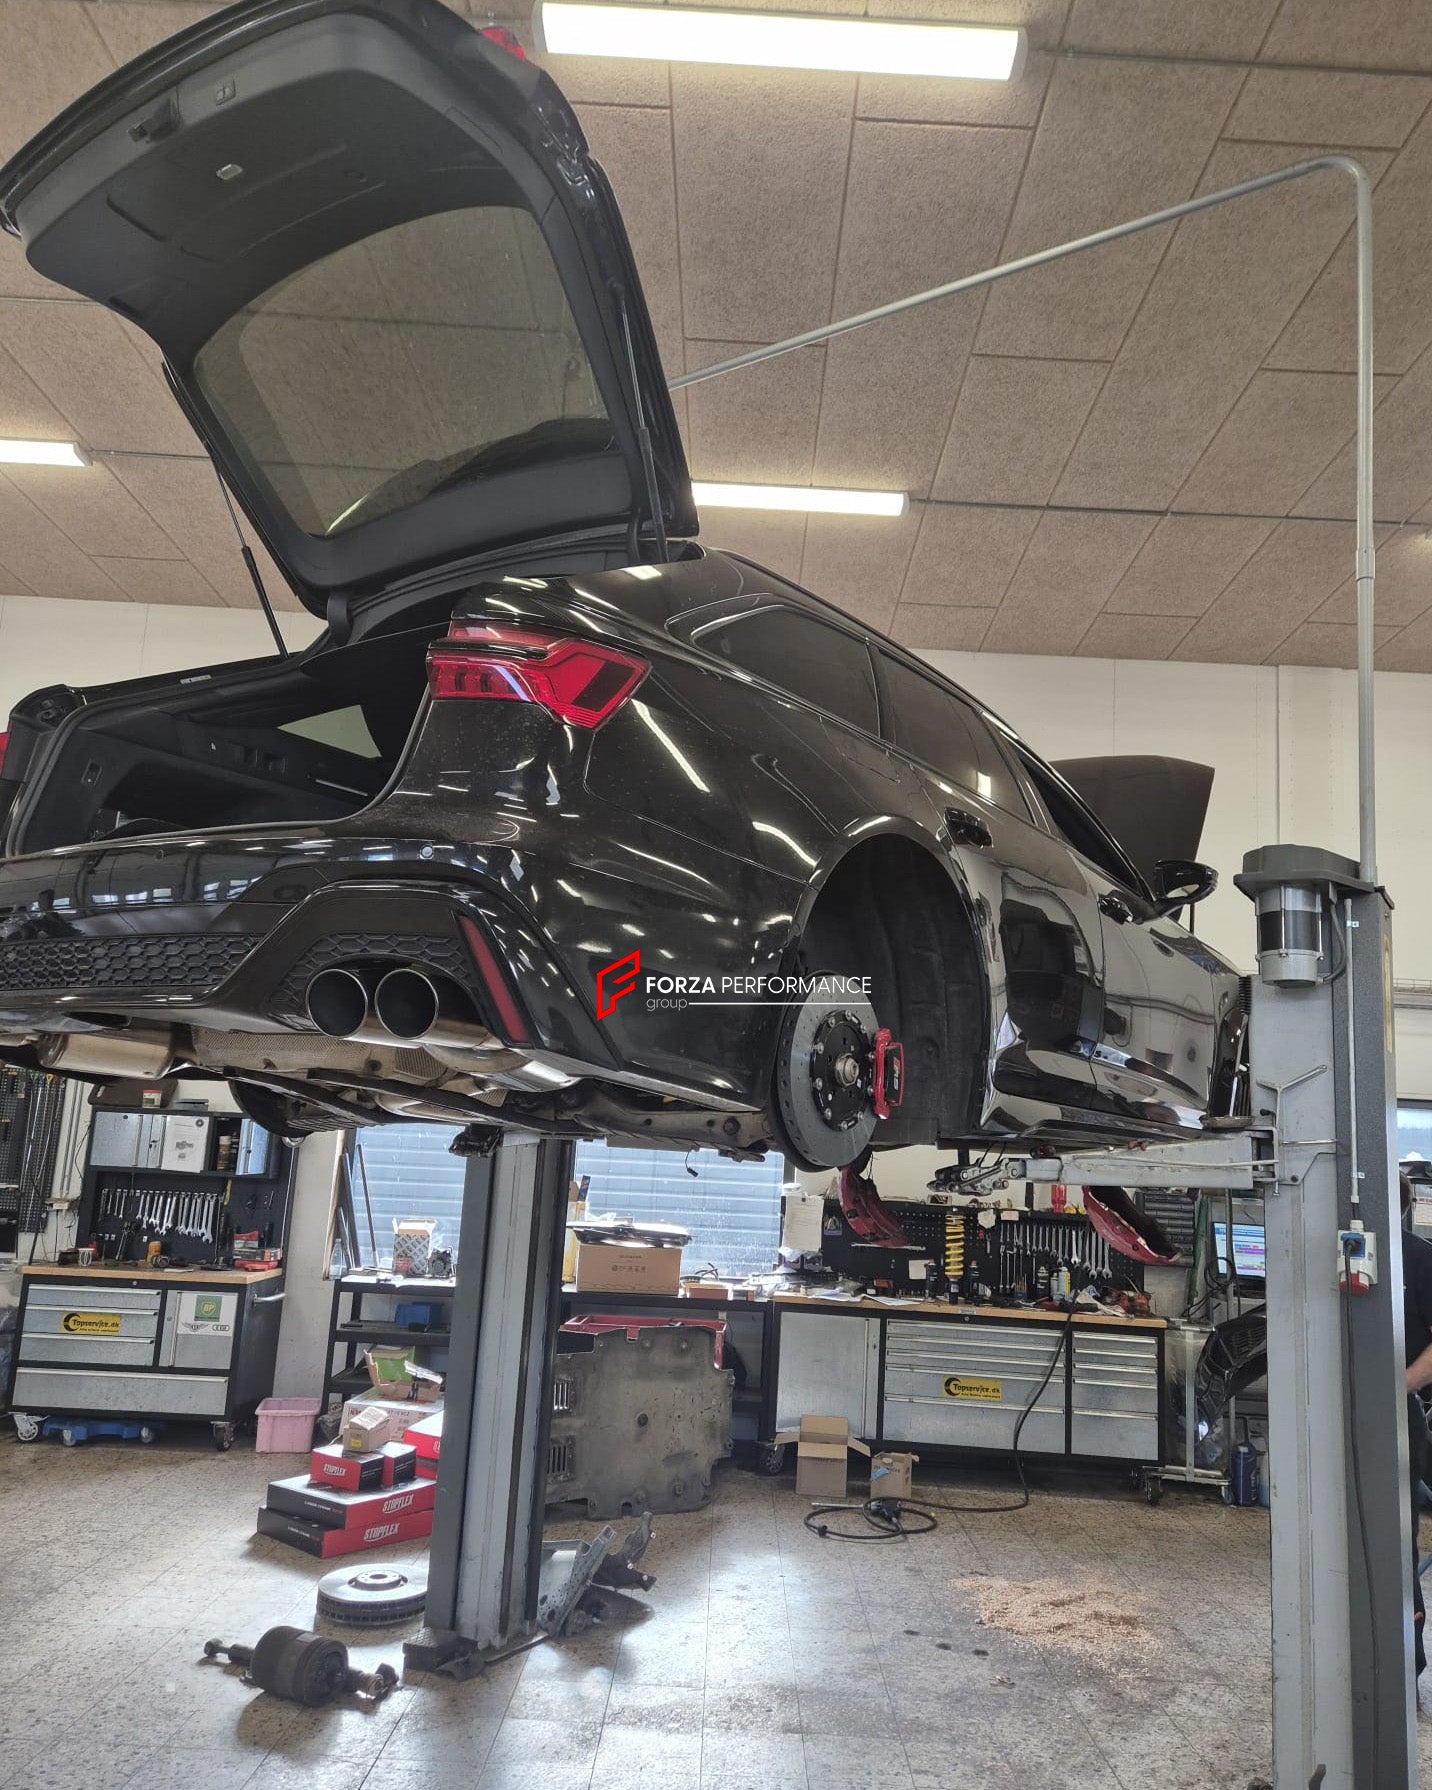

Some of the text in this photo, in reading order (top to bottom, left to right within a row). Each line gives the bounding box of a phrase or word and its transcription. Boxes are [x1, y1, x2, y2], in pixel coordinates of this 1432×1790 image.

[72, 1319, 119, 1328] Topservice.dk
[953, 1383, 1000, 1393] Topservice.dk
[323, 1463, 346, 1476] STOPFLEX
[382, 1493, 414, 1513] STOPFLEX
[363, 1522, 400, 1542] STOPFLEX
